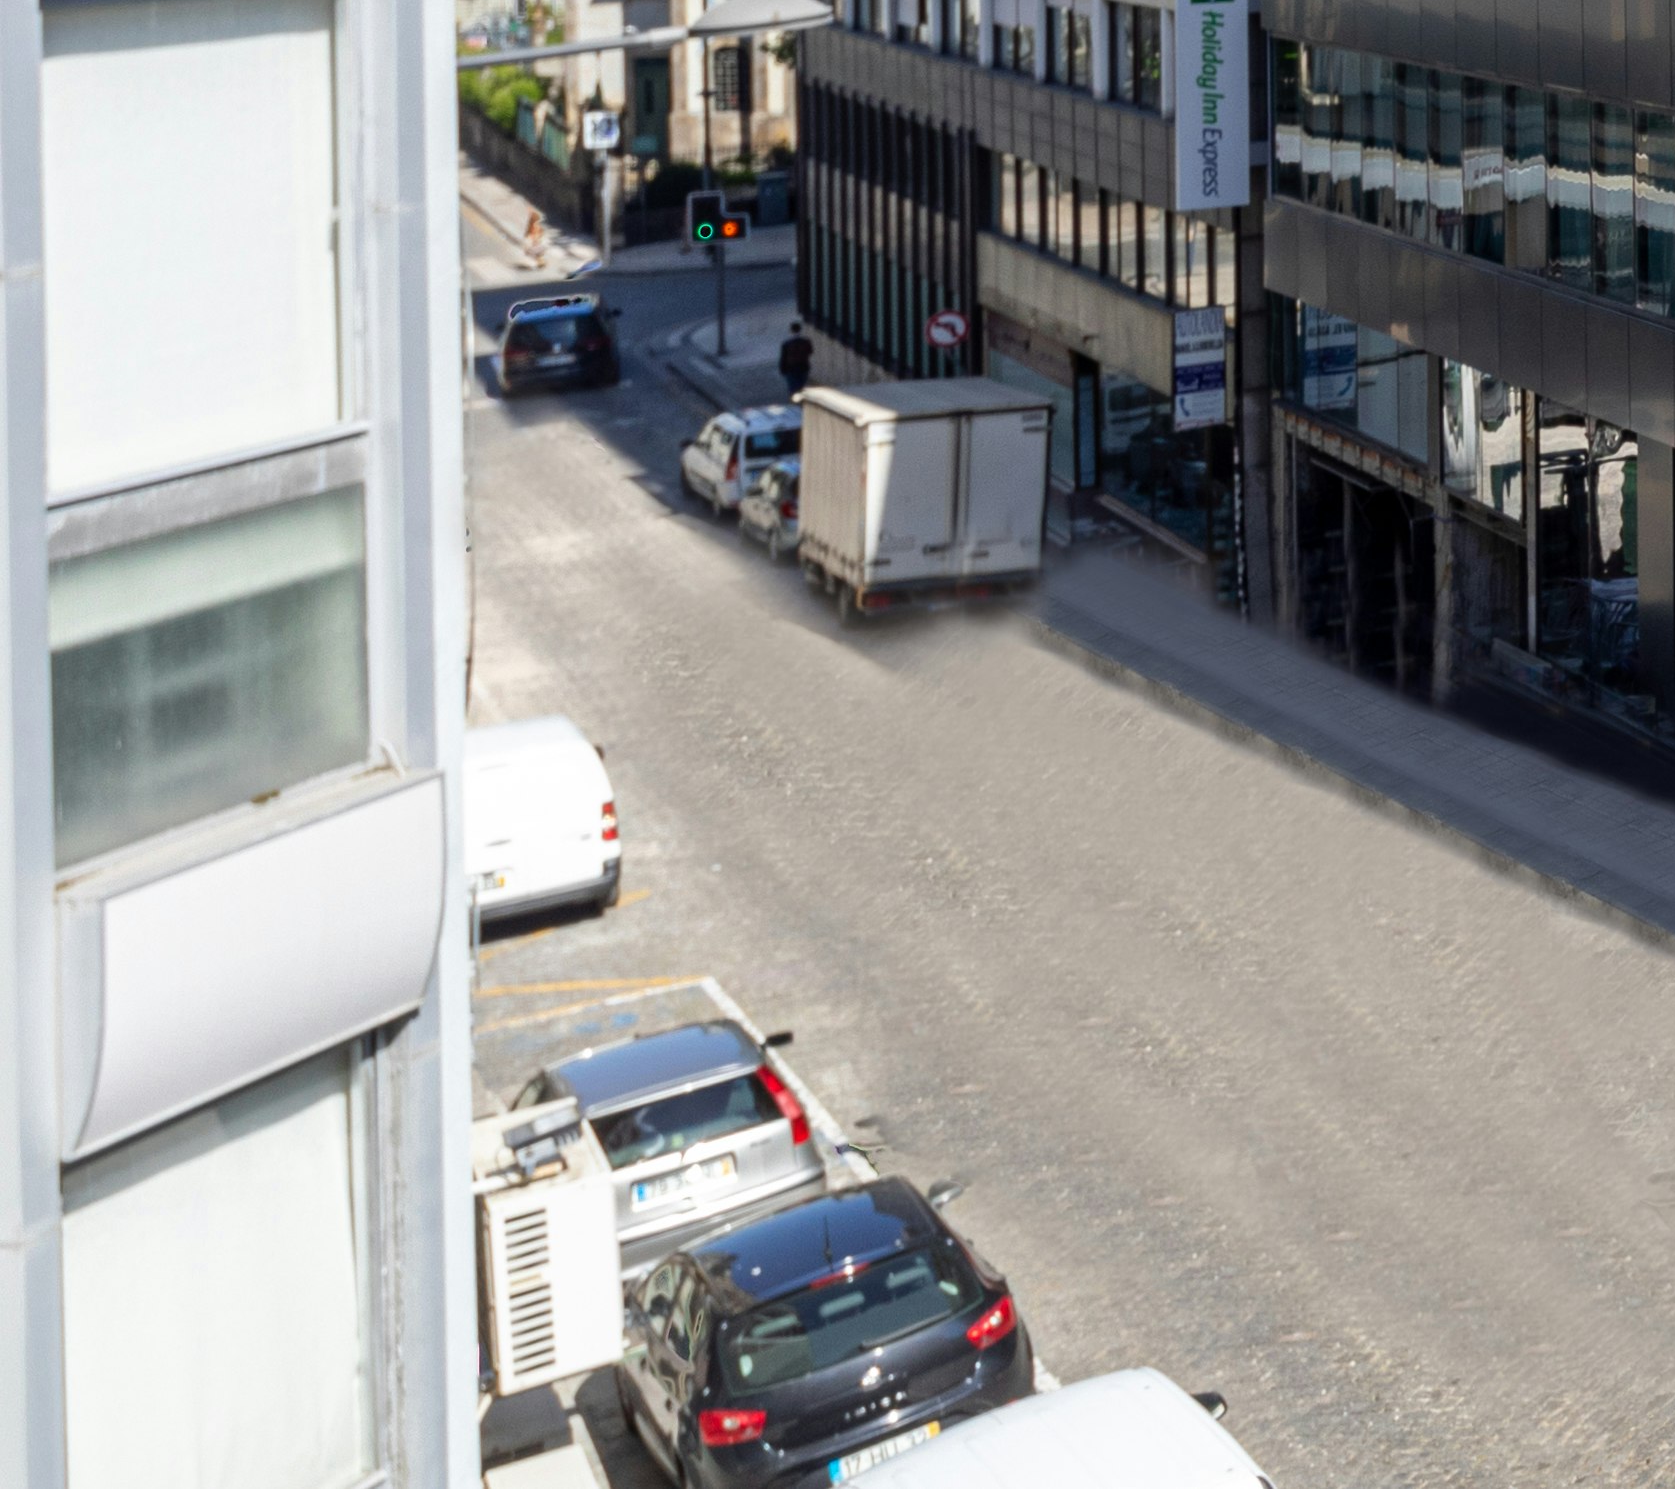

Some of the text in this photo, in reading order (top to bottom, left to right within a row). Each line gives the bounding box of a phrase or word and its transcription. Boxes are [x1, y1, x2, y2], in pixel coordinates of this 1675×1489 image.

[1196, 10, 1225, 198] Holiday Inn Express
